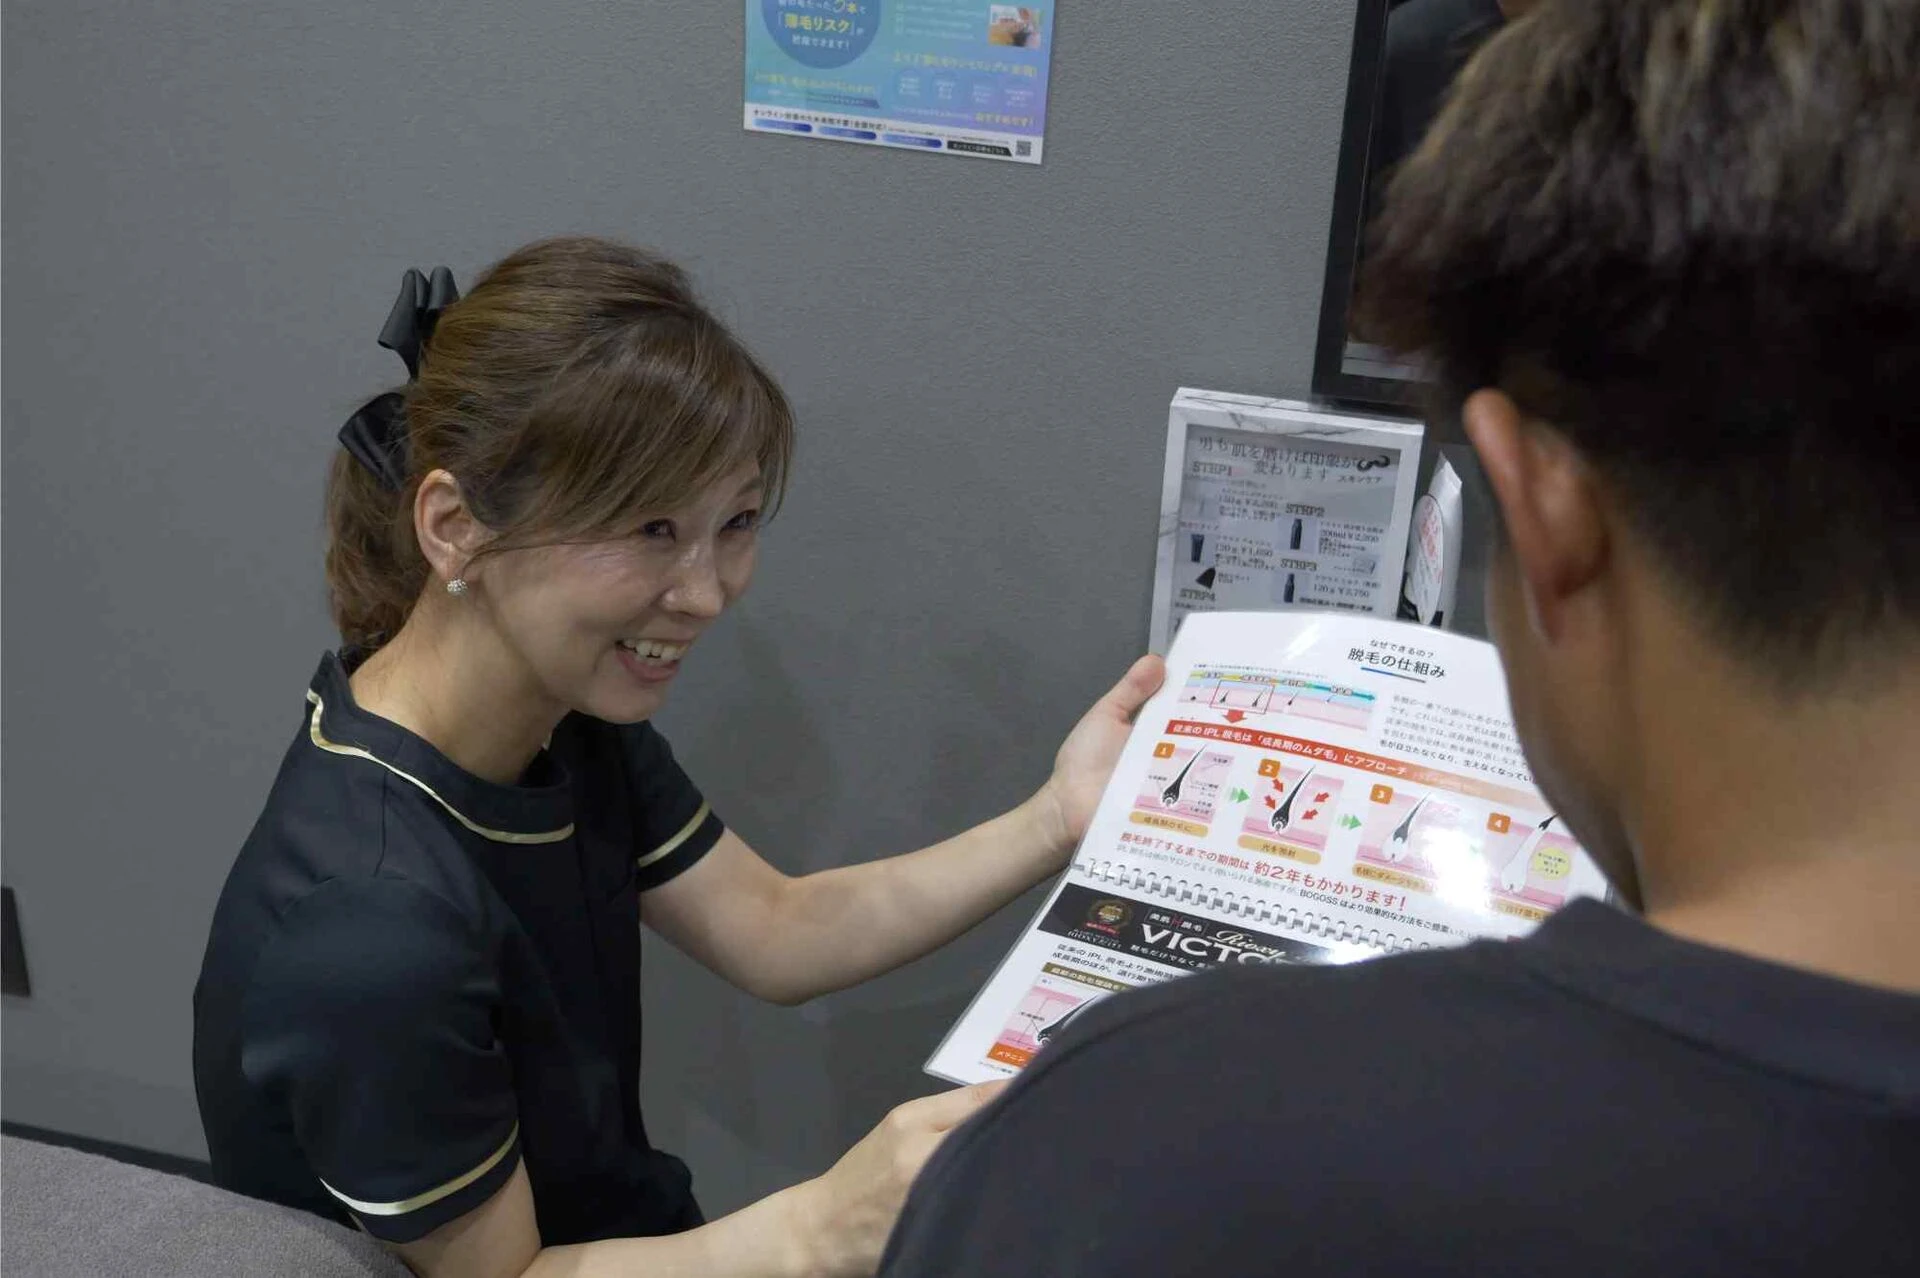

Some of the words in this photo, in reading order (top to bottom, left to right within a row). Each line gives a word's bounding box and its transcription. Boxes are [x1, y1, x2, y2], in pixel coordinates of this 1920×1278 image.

[1285, 503, 1325, 518] STEP2
[1280, 558, 1317, 571] STEP3
[1348, 648, 1445, 678] 脱毛の仕組み
[1160, 746, 1167, 755] 1
[1265, 764, 1274, 773] 2
[1377, 790, 1385, 799] 3
[1494, 819, 1503, 828] 4
